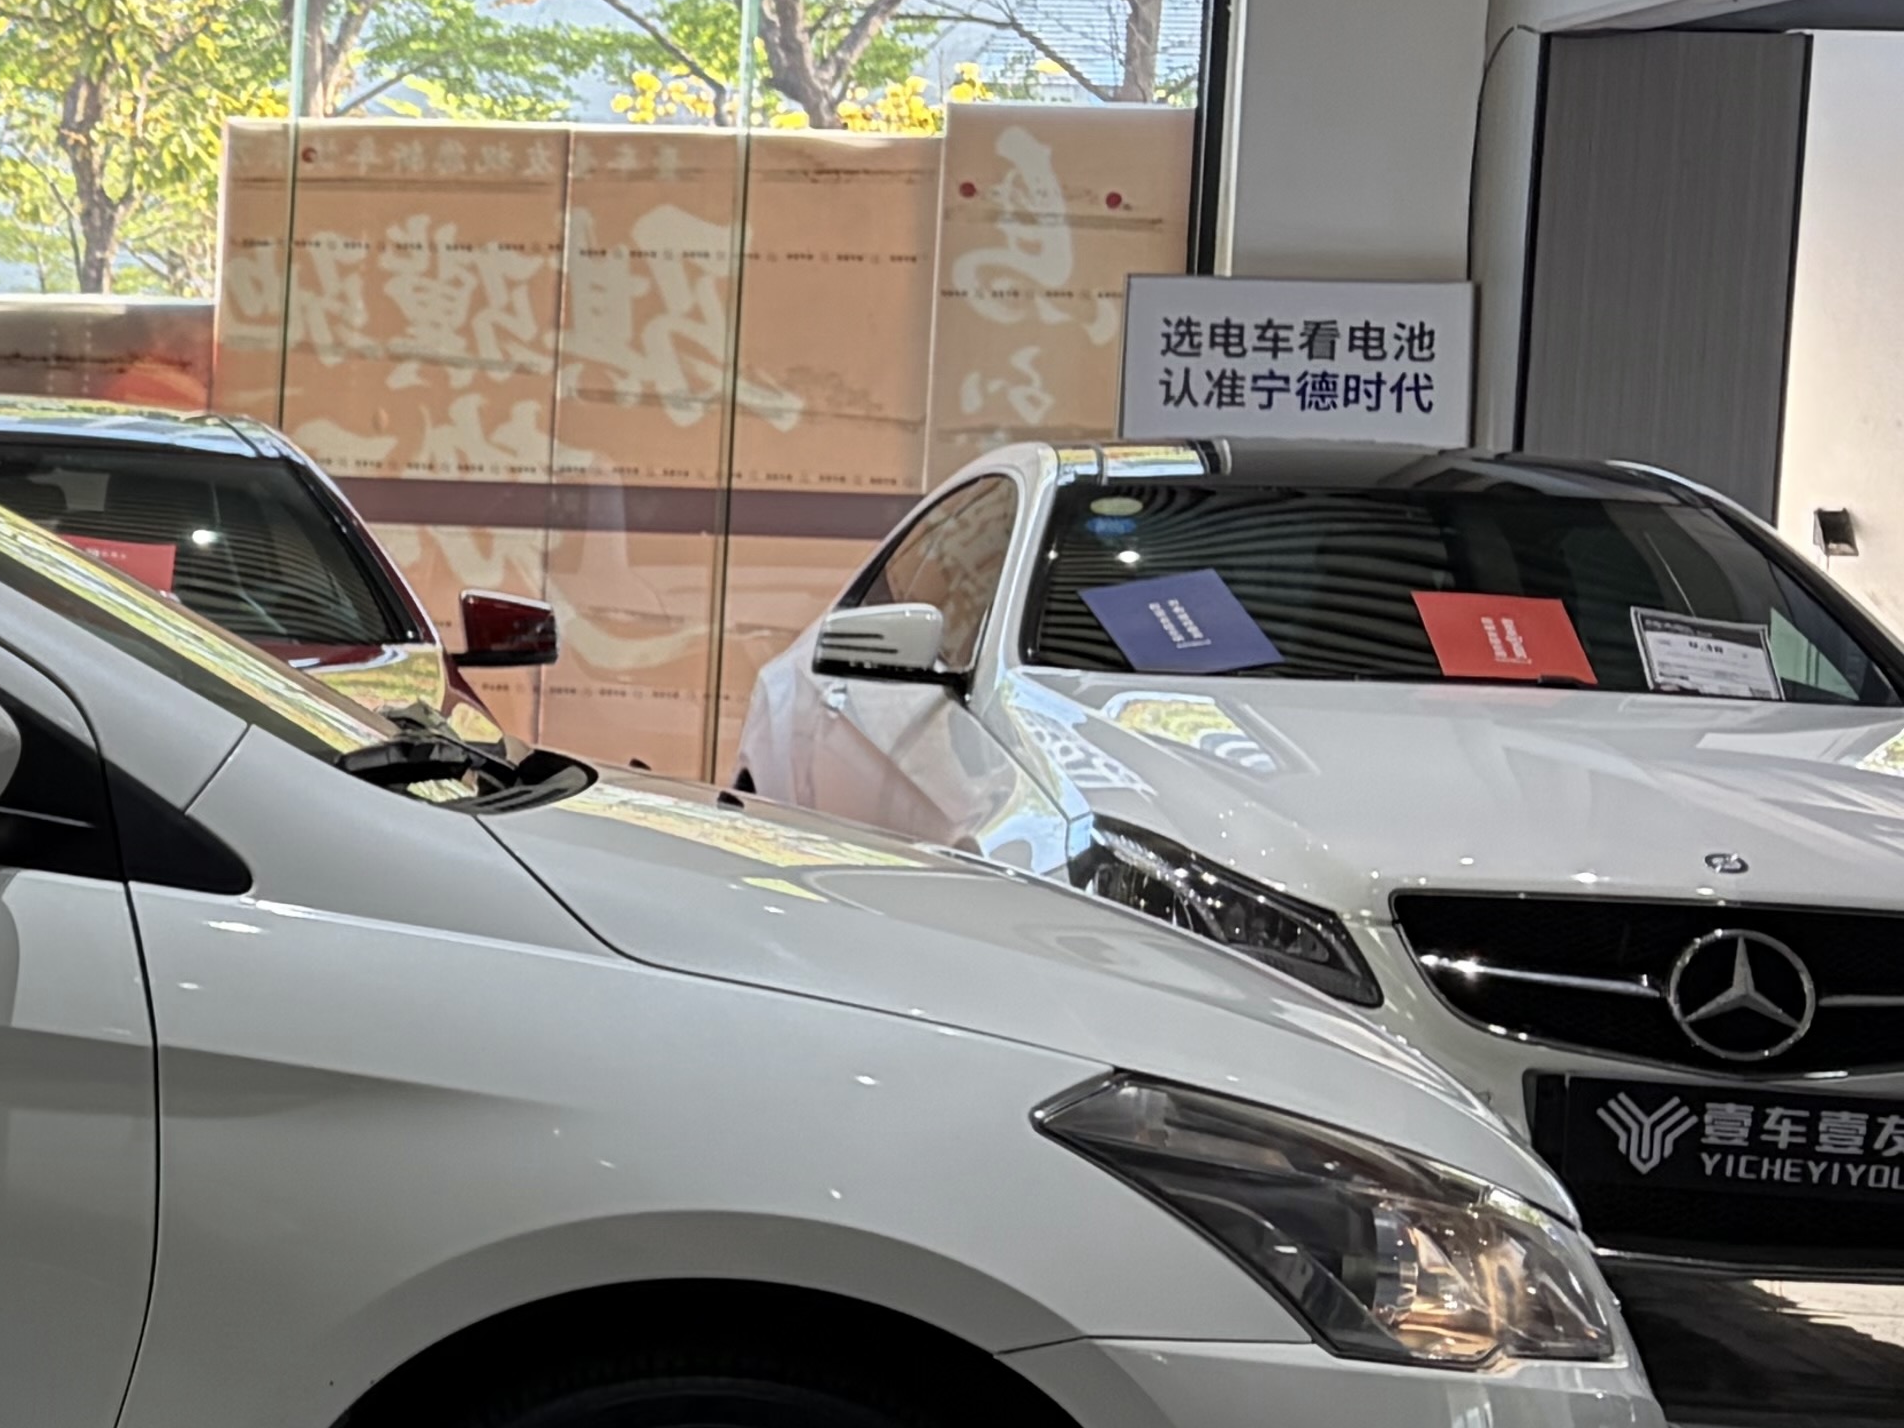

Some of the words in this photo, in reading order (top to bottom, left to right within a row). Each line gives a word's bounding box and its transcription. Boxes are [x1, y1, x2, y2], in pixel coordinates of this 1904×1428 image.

[1159, 315, 1436, 363] 选电车看电池
[1158, 366, 1435, 415] 认准宁德时代
[1700, 1102, 1904, 1158] 壹车壹友
